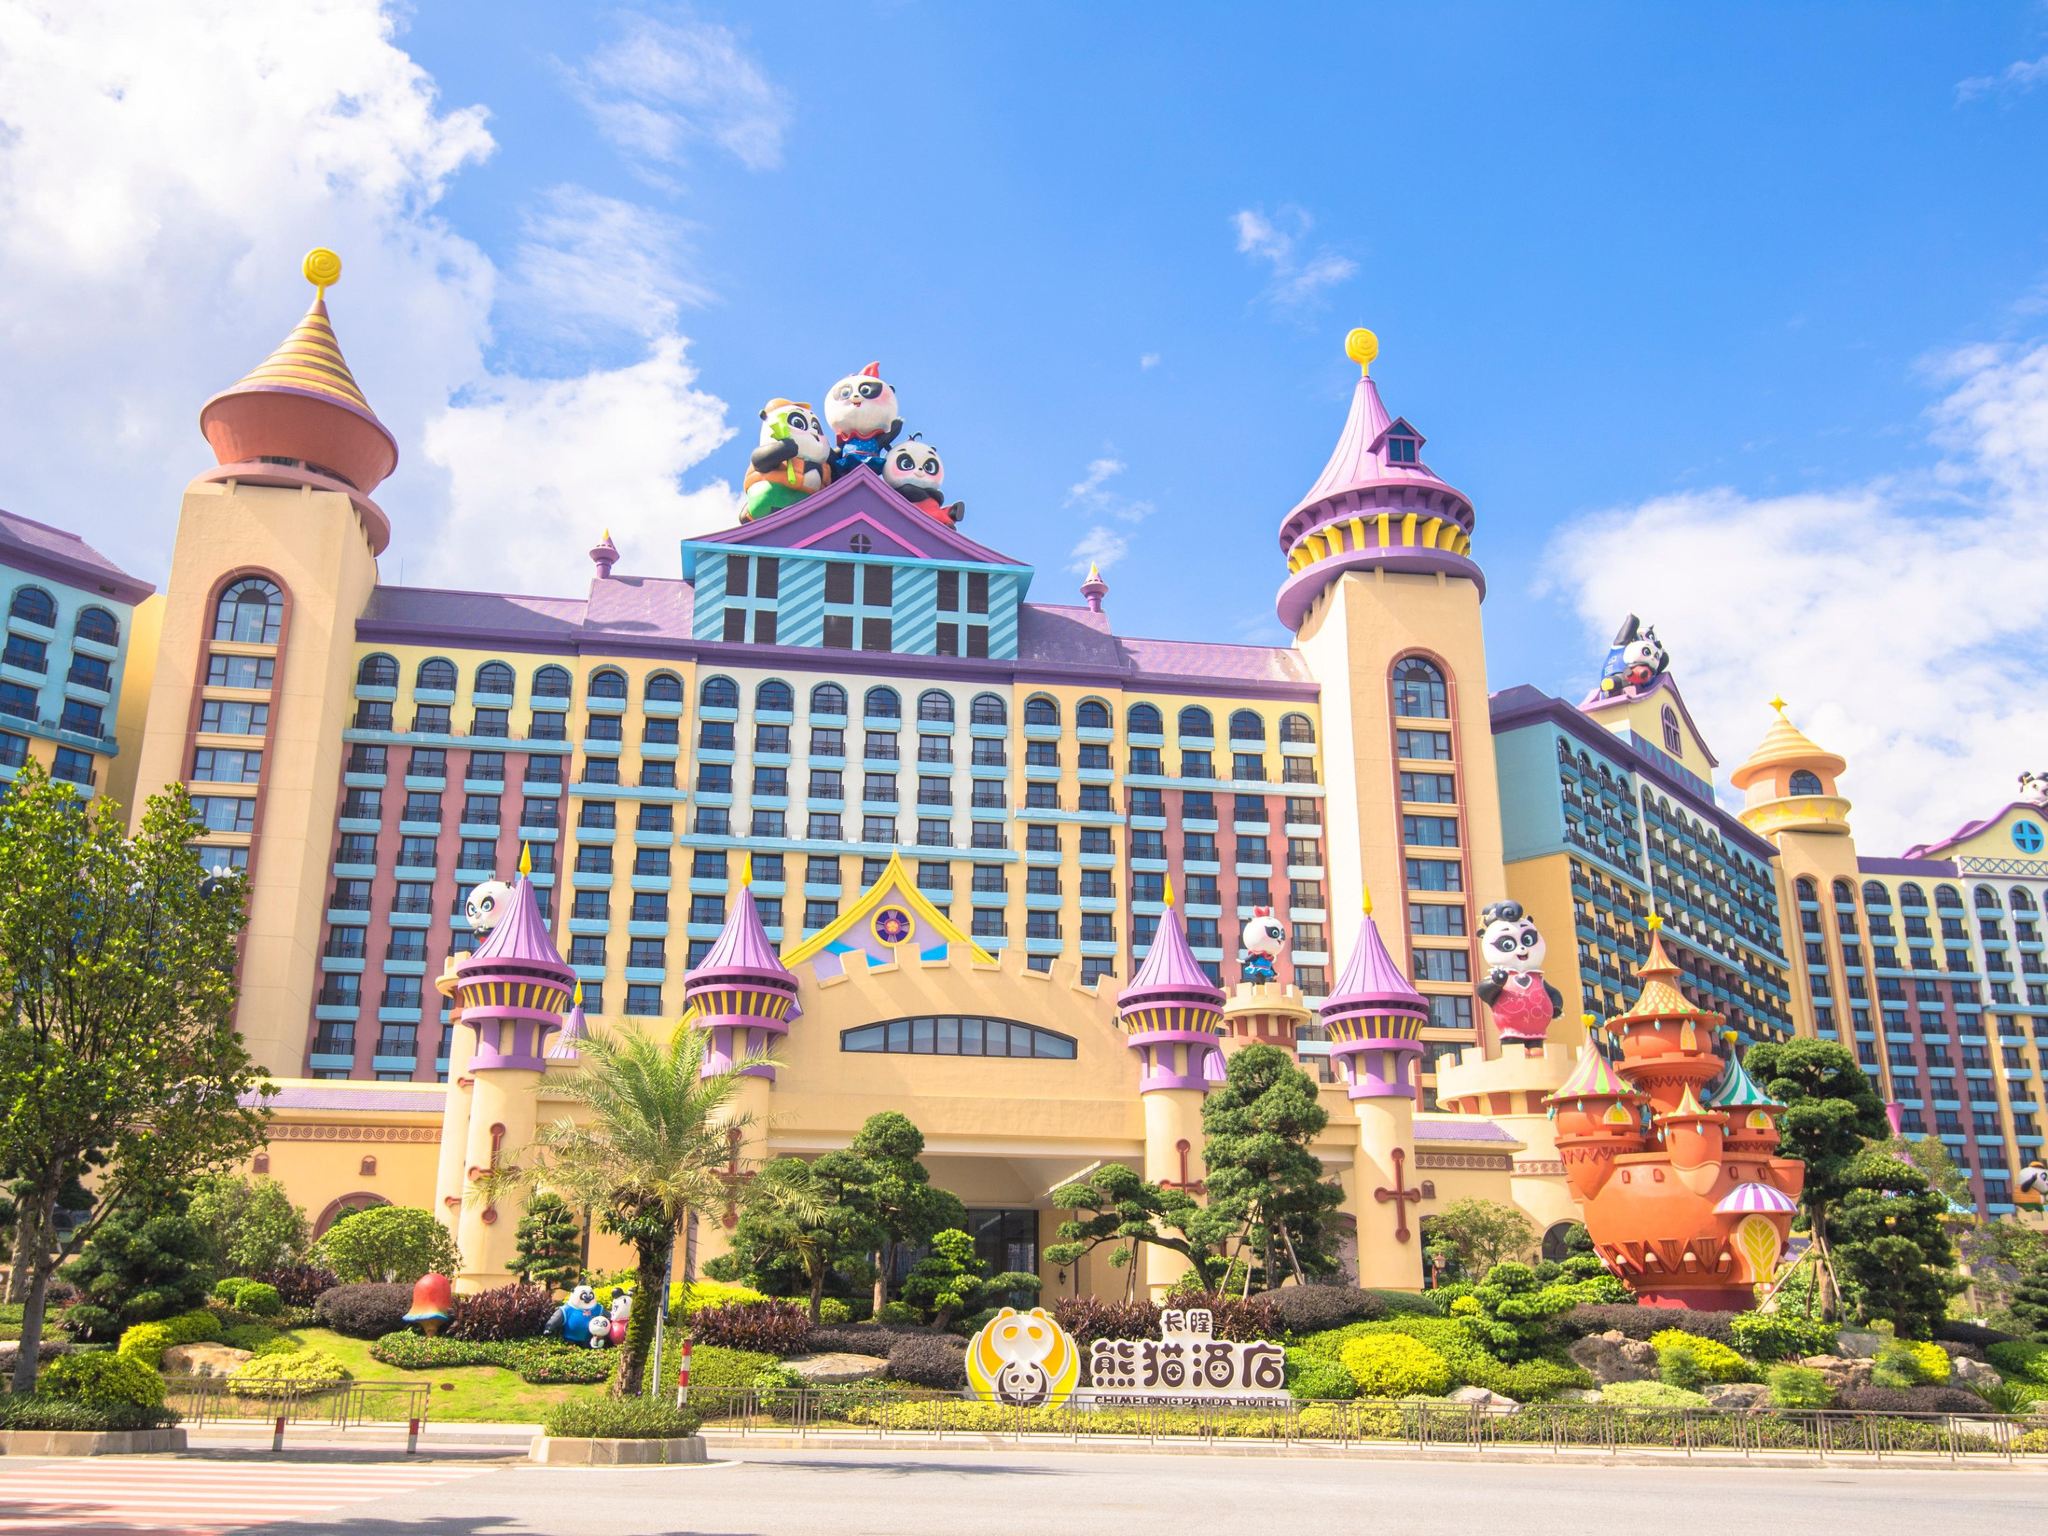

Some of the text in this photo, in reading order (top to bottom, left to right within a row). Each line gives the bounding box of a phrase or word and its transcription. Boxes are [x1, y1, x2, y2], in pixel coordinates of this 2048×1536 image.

[1164, 1312, 1210, 1333] 长隆
[1094, 1342, 1282, 1388] 熊猫酒店
[1095, 1396, 1281, 1407] CHIMELONG PANDA HOTEL
